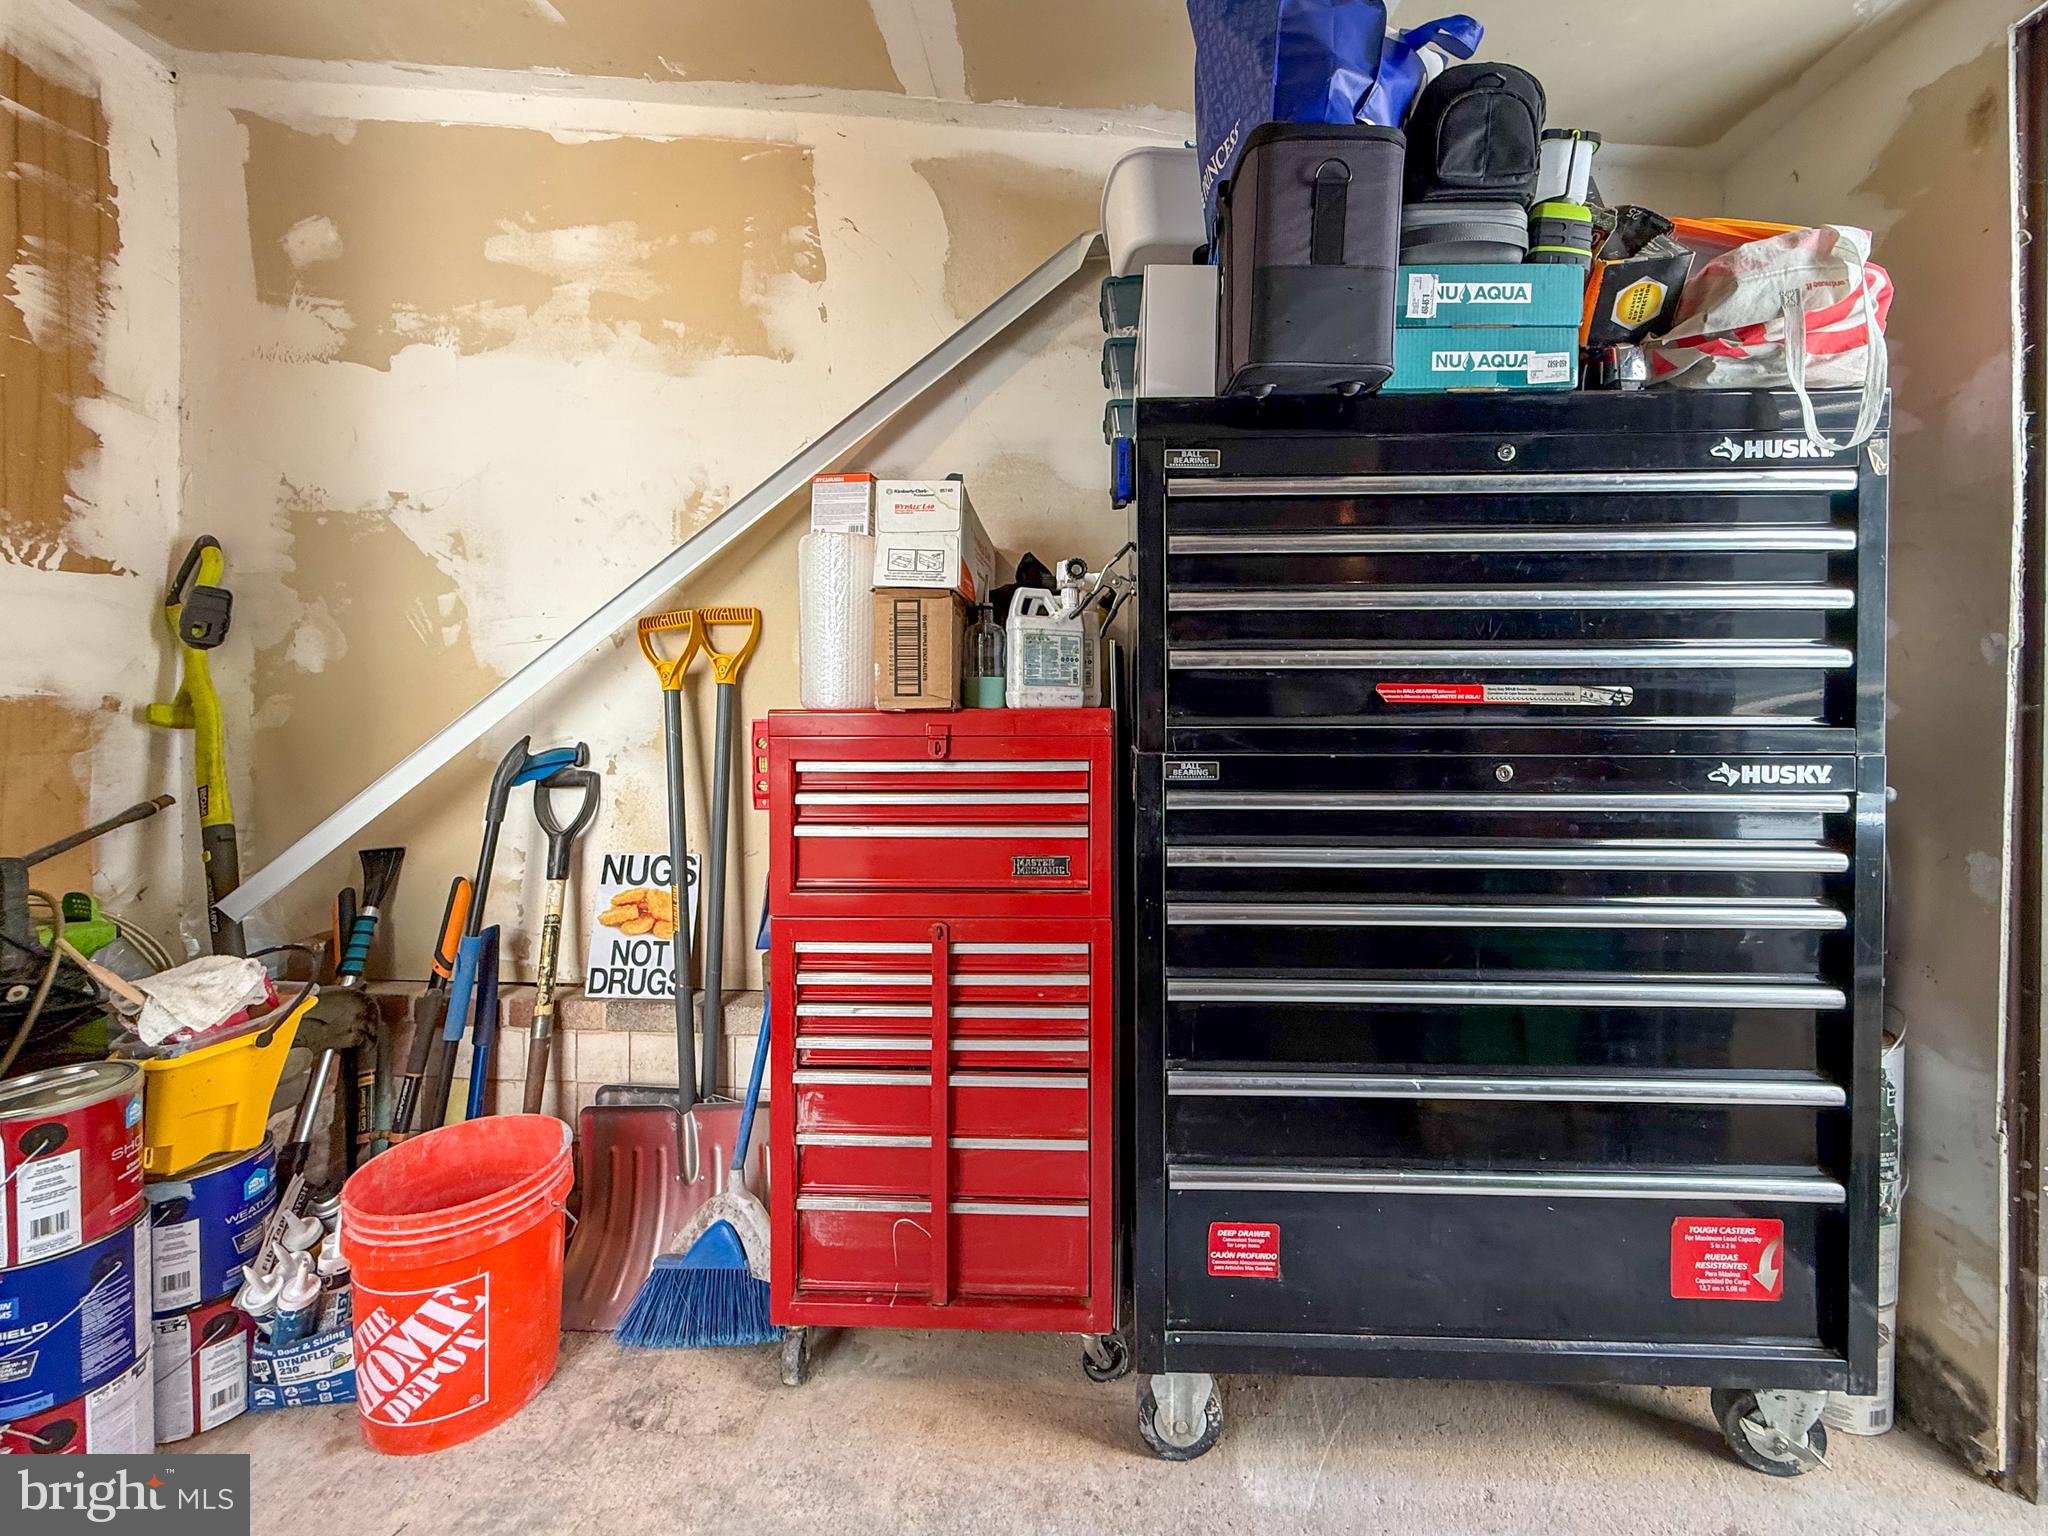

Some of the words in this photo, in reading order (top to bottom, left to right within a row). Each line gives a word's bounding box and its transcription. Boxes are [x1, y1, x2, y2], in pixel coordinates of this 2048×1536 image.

[1473, 286, 1528, 301] AQUA
[1435, 353, 1461, 368] NU
[1477, 353, 1528, 369] AQUA
[1181, 450, 1202, 458] BALL
[1173, 456, 1209, 464] BEARING
[1180, 762, 1201, 770] BALL
[1741, 765, 1833, 784] HUSKY
[1016, 858, 1055, 866] MASTER
[601, 854, 697, 887] NUGS
[1016, 866, 1065, 875] MECHANIC
[611, 940, 670, 967] NOT
[1238, 1230, 1271, 1238] DRAWER
[1689, 1226, 1718, 1234] TOUGH
[1719, 1227, 1756, 1235] CASTERS
[1211, 1249, 1235, 1259] CAJÓN
[1236, 1252, 1277, 1260] PROFUNDO
[1704, 1253, 1739, 1261] RUEDAS
[1695, 1262, 1748, 1270] RESISTENTES
[356, 1306, 397, 1353] THE
[277, 1346, 299, 1357] Door
[302, 1342, 311, 1351] &
[312, 1329, 346, 1346] Siding
[277, 1345, 335, 1368] DYNAFLEX
[356, 1287, 487, 1416] HOME
[279, 1366, 300, 1376] 230
[382, 1329, 486, 1424] DEPOT
